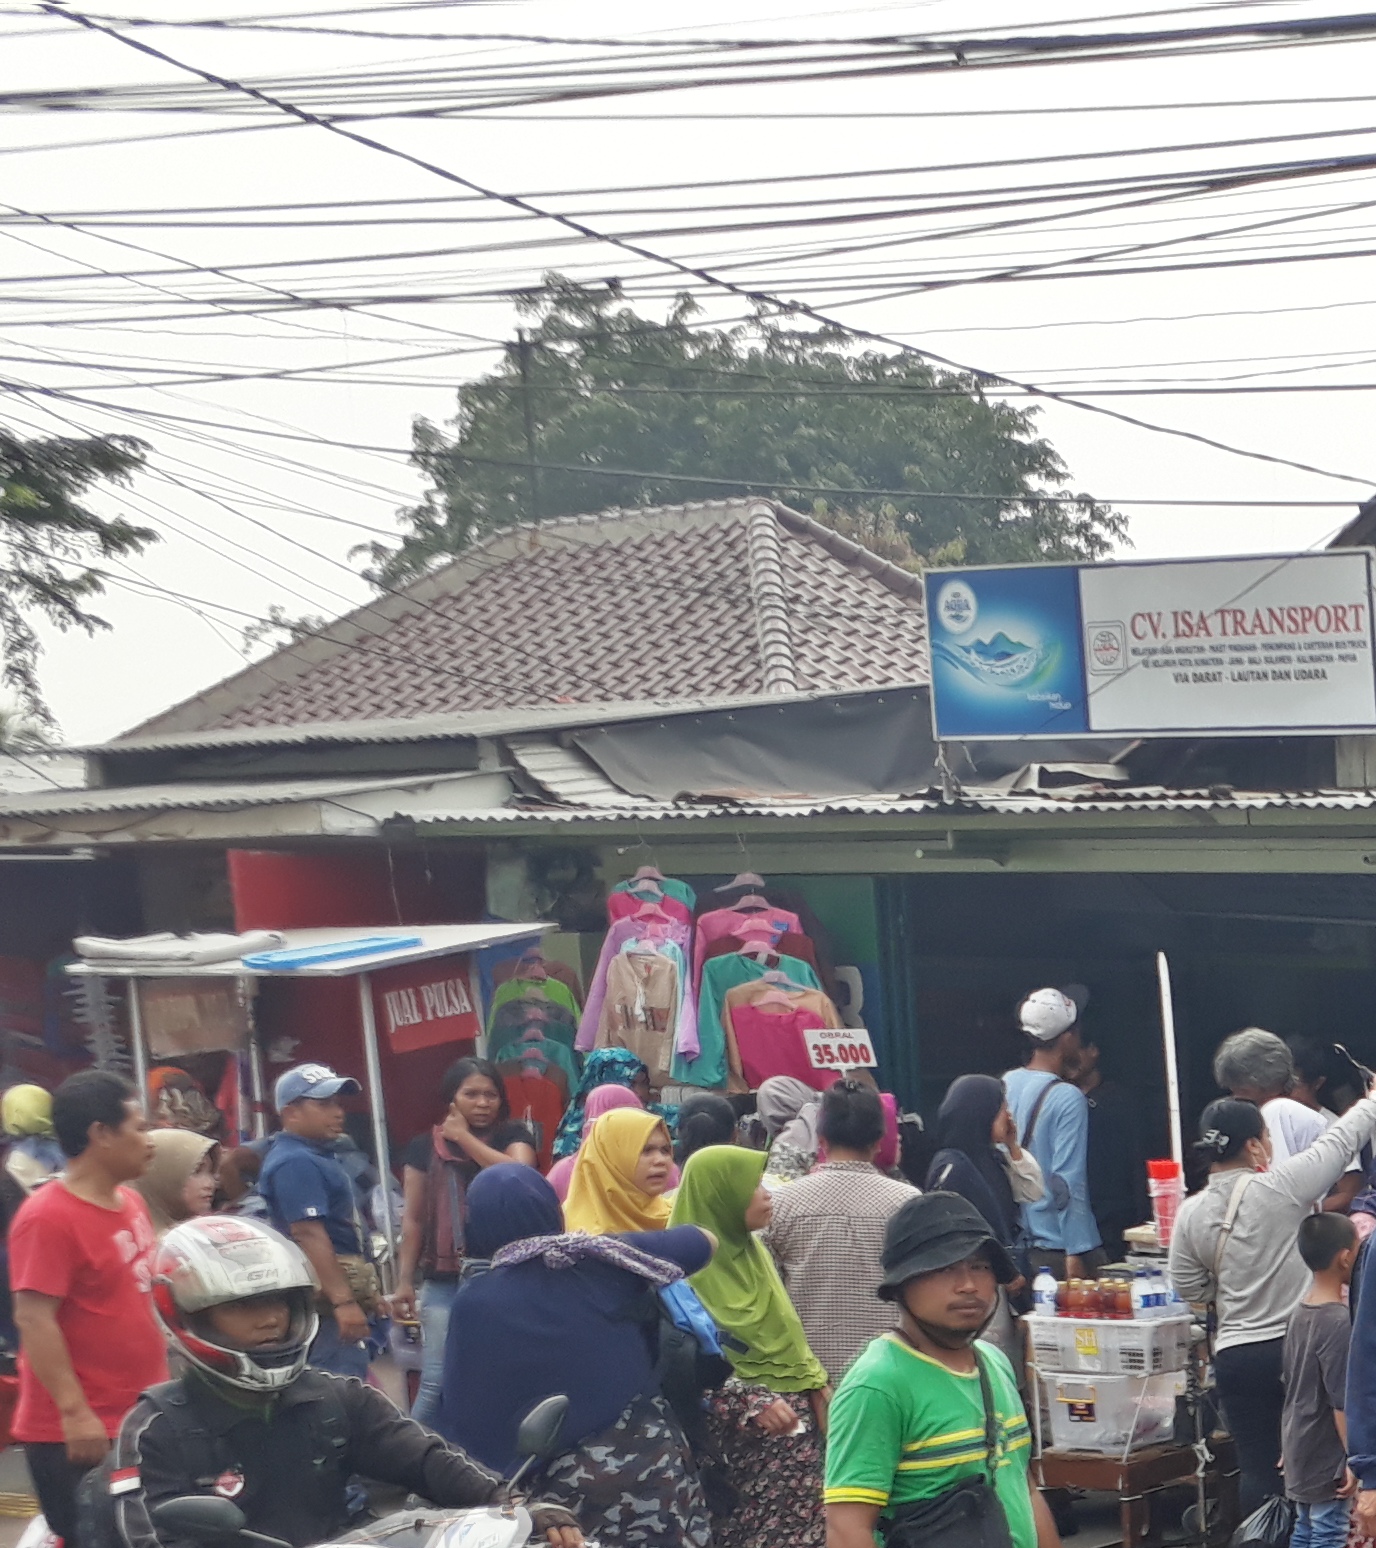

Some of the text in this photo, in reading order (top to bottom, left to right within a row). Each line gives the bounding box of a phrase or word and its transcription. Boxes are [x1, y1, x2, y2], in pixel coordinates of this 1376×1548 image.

[1131, 604, 1365, 640] CV. ISA TRANSPORT
[1173, 668, 1328, 683] VIA DARAT LAUTAN DAN UDARA
[385, 978, 472, 1033] JUAL PULSA
[812, 1043, 871, 1064] 35.000
